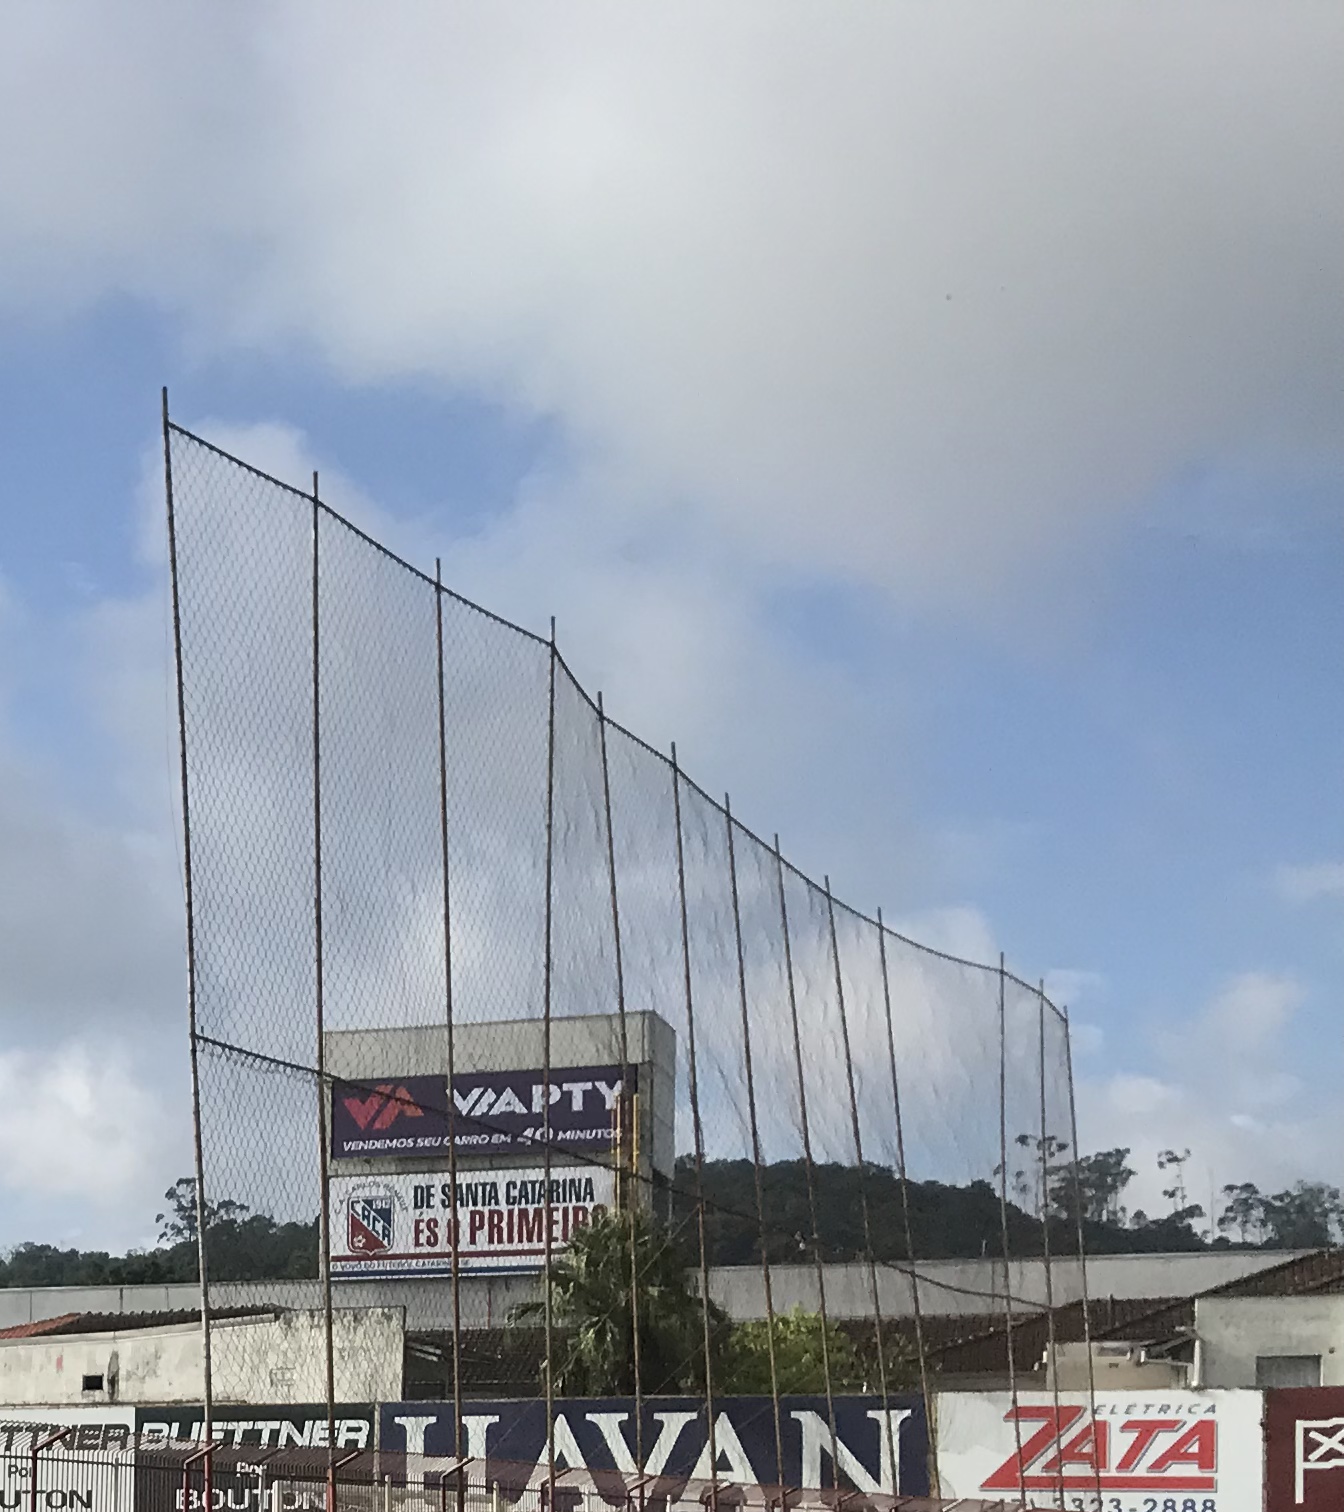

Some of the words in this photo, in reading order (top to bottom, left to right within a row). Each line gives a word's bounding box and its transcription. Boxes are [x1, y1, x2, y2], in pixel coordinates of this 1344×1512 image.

[343, 1138, 414, 1151] VENDEMOS
[415, 1136, 442, 1148] SEU
[443, 1134, 490, 1147] CARRO
[491, 1134, 512, 1144] EM
[516, 1127, 554, 1146] 40
[557, 1128, 623, 1141] MINUTOS
[413, 1184, 435, 1209] DE
[441, 1181, 499, 1209] SANTA
[505, 1177, 595, 1206] CATARINA
[414, 1211, 439, 1248] ÉS
[469, 1203, 609, 1246] PRIMEIR
[394, 1410, 913, 1508] HAVAN
[979, 1405, 1218, 1492] ZATA
